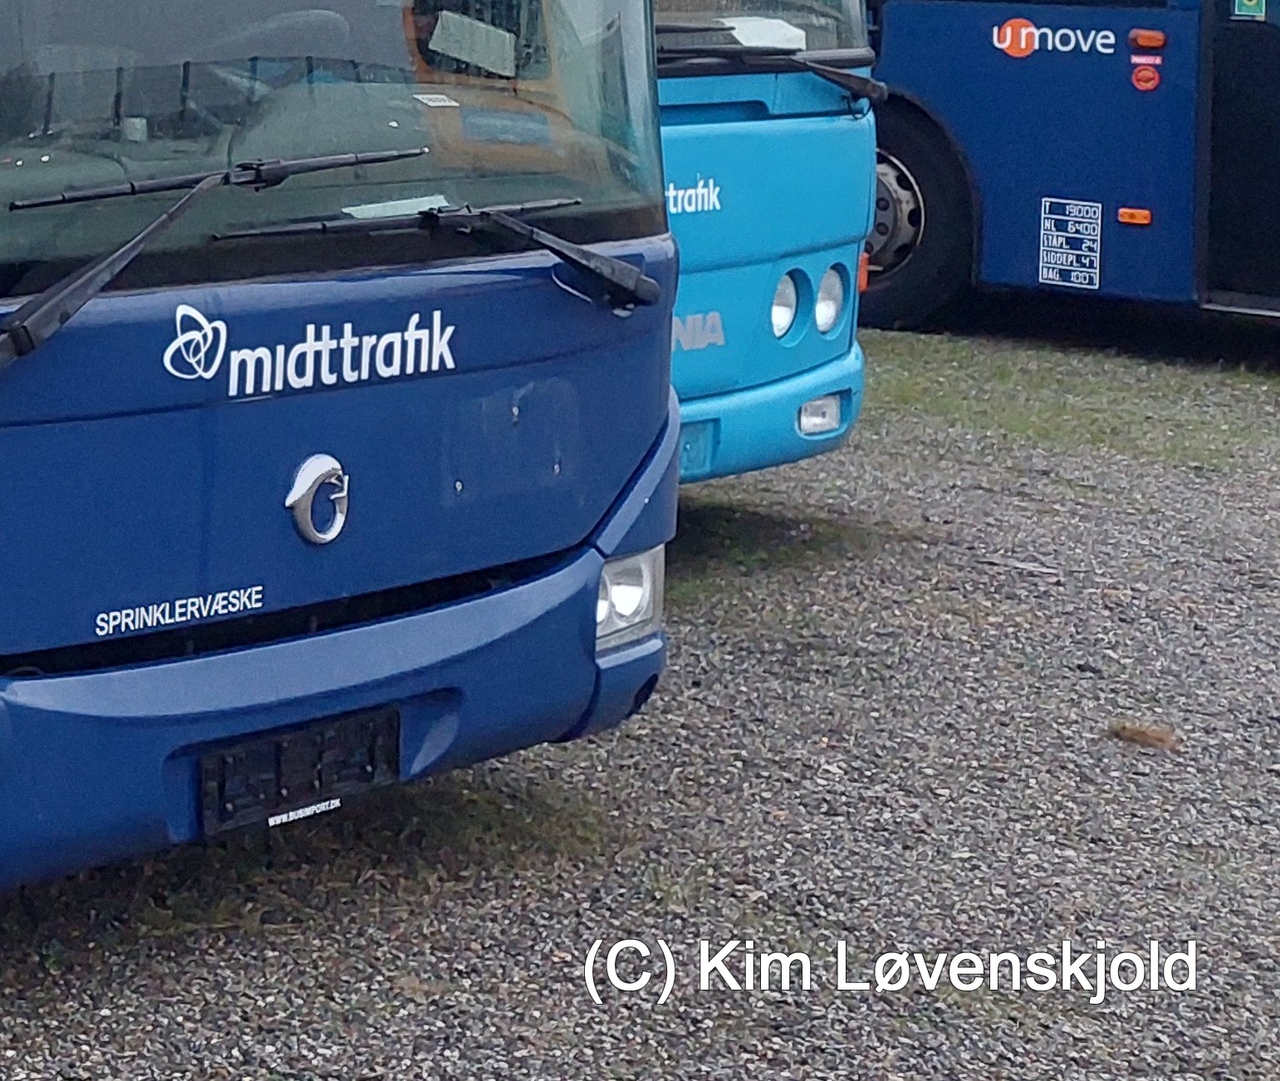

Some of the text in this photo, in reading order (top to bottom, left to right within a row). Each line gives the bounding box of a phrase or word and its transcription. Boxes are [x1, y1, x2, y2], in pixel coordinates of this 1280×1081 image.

[666, 178, 721, 214] trafik
[1044, 202, 1099, 218] T 19000
[1044, 218, 1098, 235] NL 6400
[1081, 239, 1097, 251] 24
[1081, 256, 1097, 268] 47
[228, 310, 455, 396] midttrafik
[95, 586, 263, 636] SPRINKLERVÆSKE
